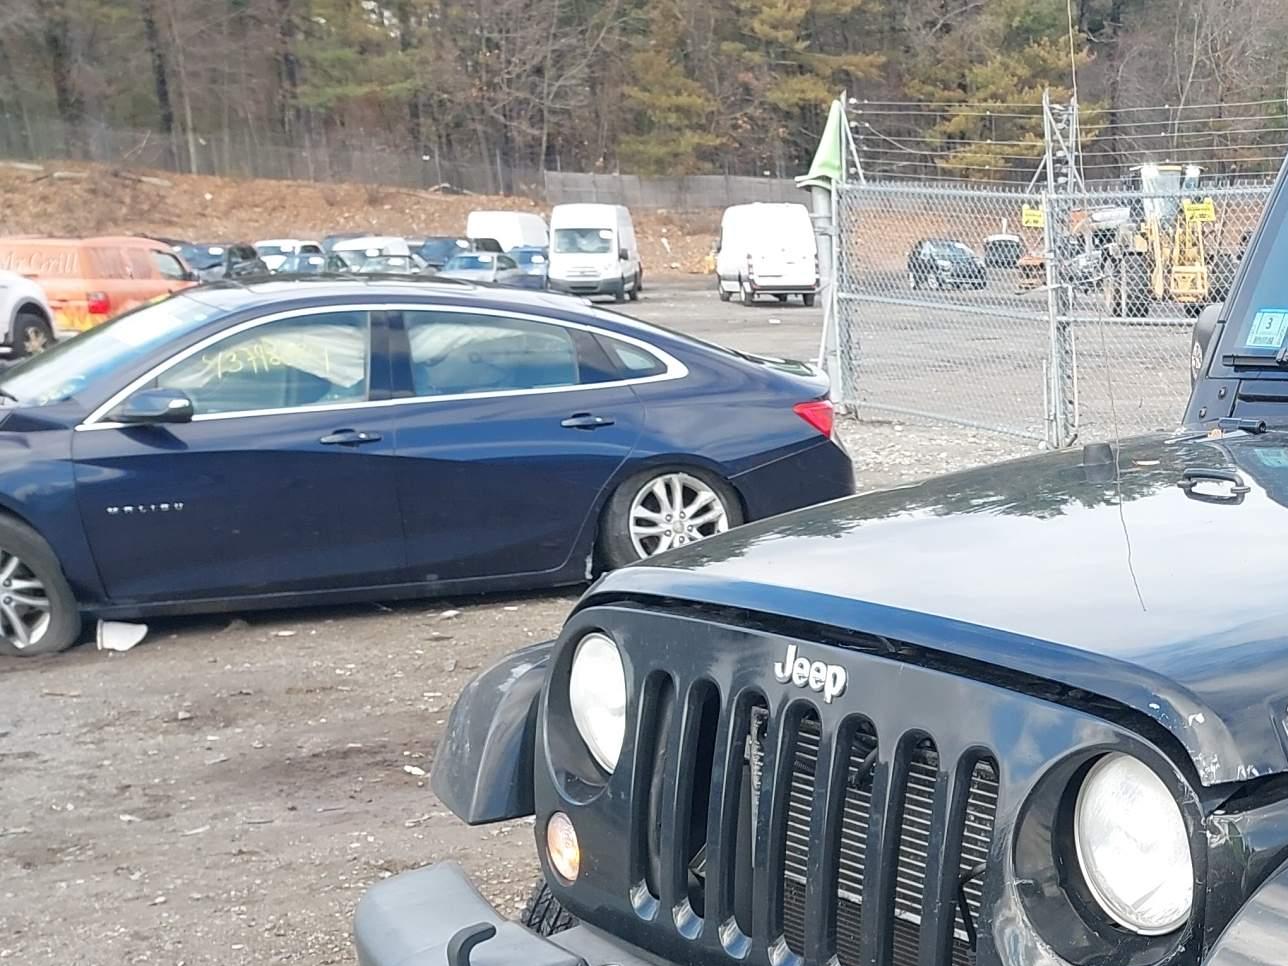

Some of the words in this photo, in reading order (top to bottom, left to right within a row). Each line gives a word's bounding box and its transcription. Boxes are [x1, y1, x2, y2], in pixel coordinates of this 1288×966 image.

[1265, 317, 1274, 330] 3
[106, 502, 184, 515] MALIBU
[774, 644, 848, 704] Jeep
